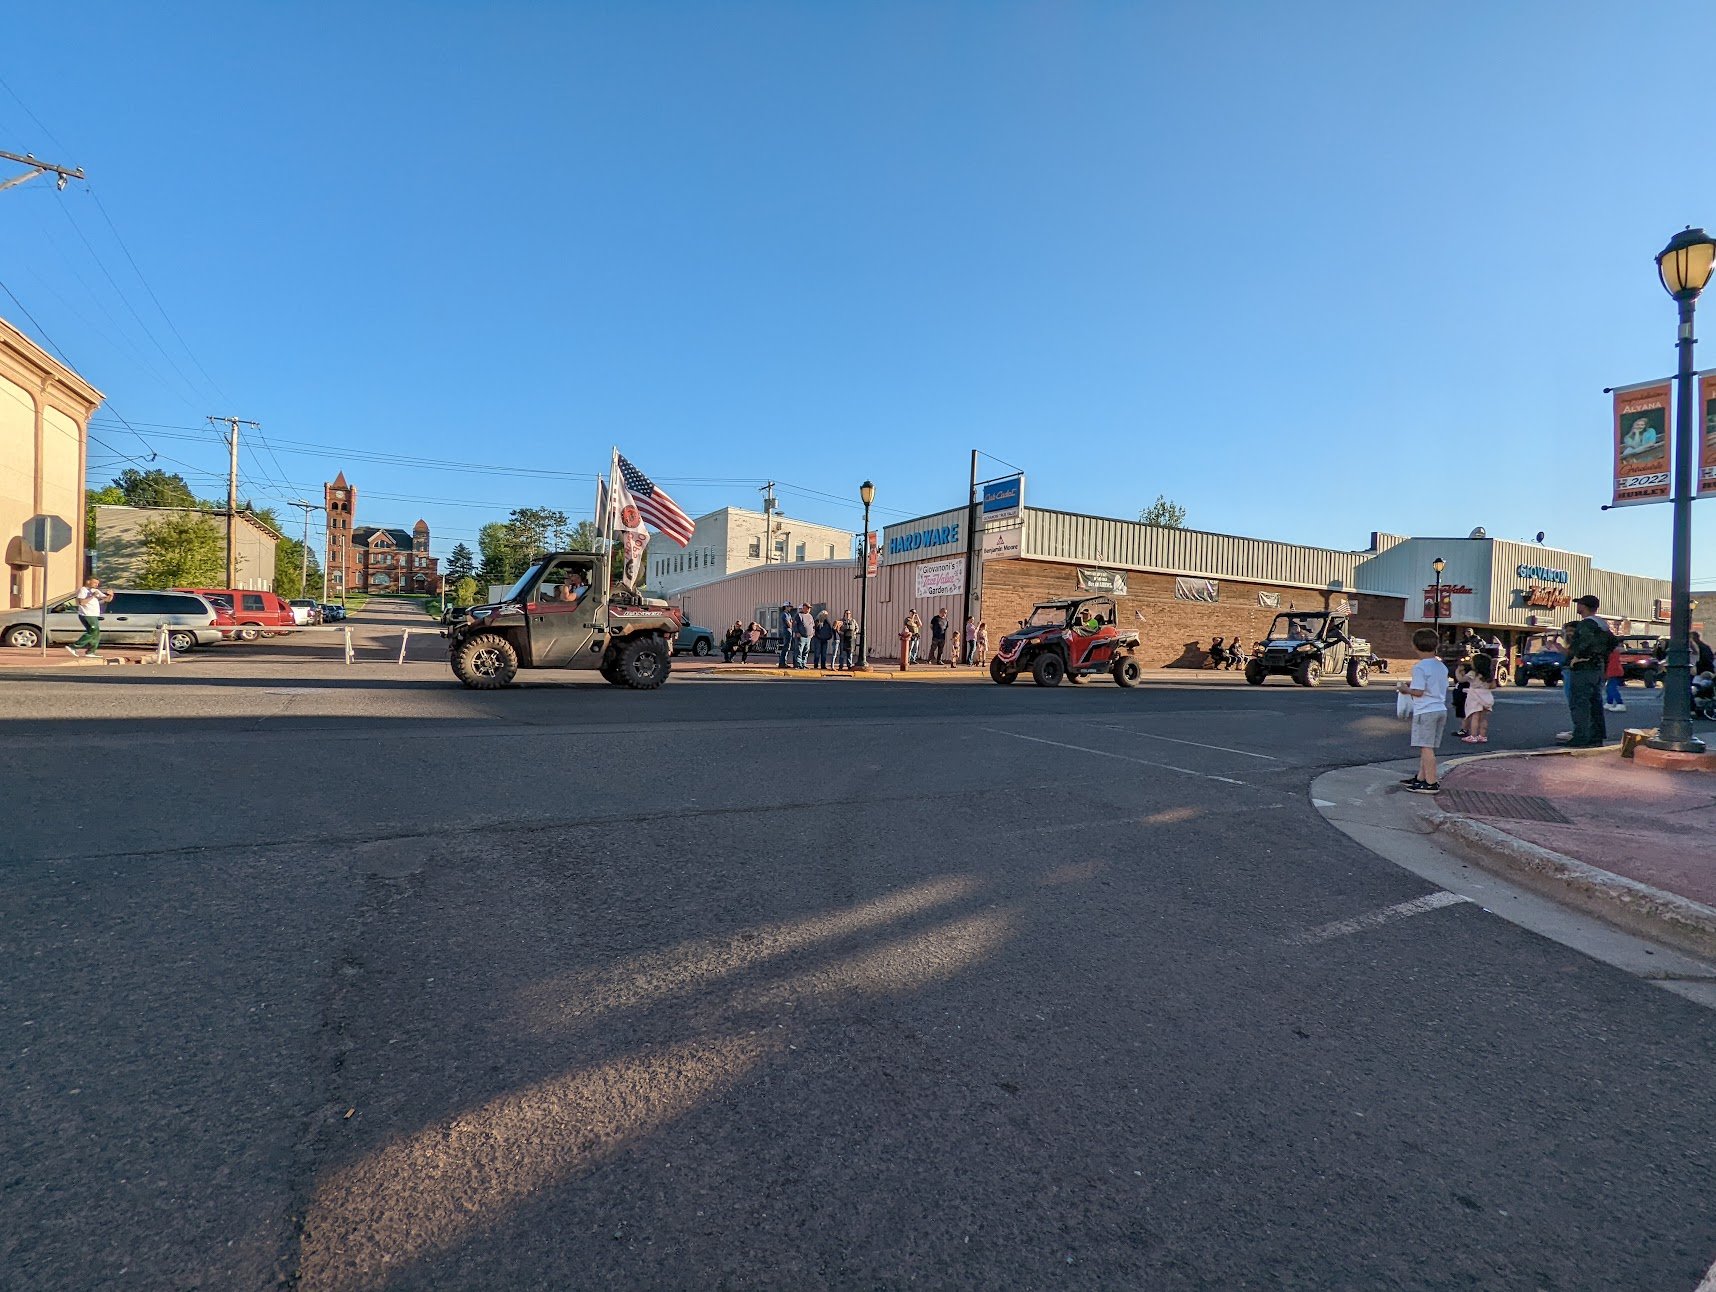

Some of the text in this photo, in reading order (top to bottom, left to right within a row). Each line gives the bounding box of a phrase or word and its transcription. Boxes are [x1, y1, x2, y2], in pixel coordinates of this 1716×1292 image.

[1628, 473, 1669, 487] 2022
[1618, 487, 1668, 499] HURLEY
[890, 524, 960, 554] HARDWARE
[922, 562, 956, 574] Giovanoni's
[928, 585, 949, 595] Garden
